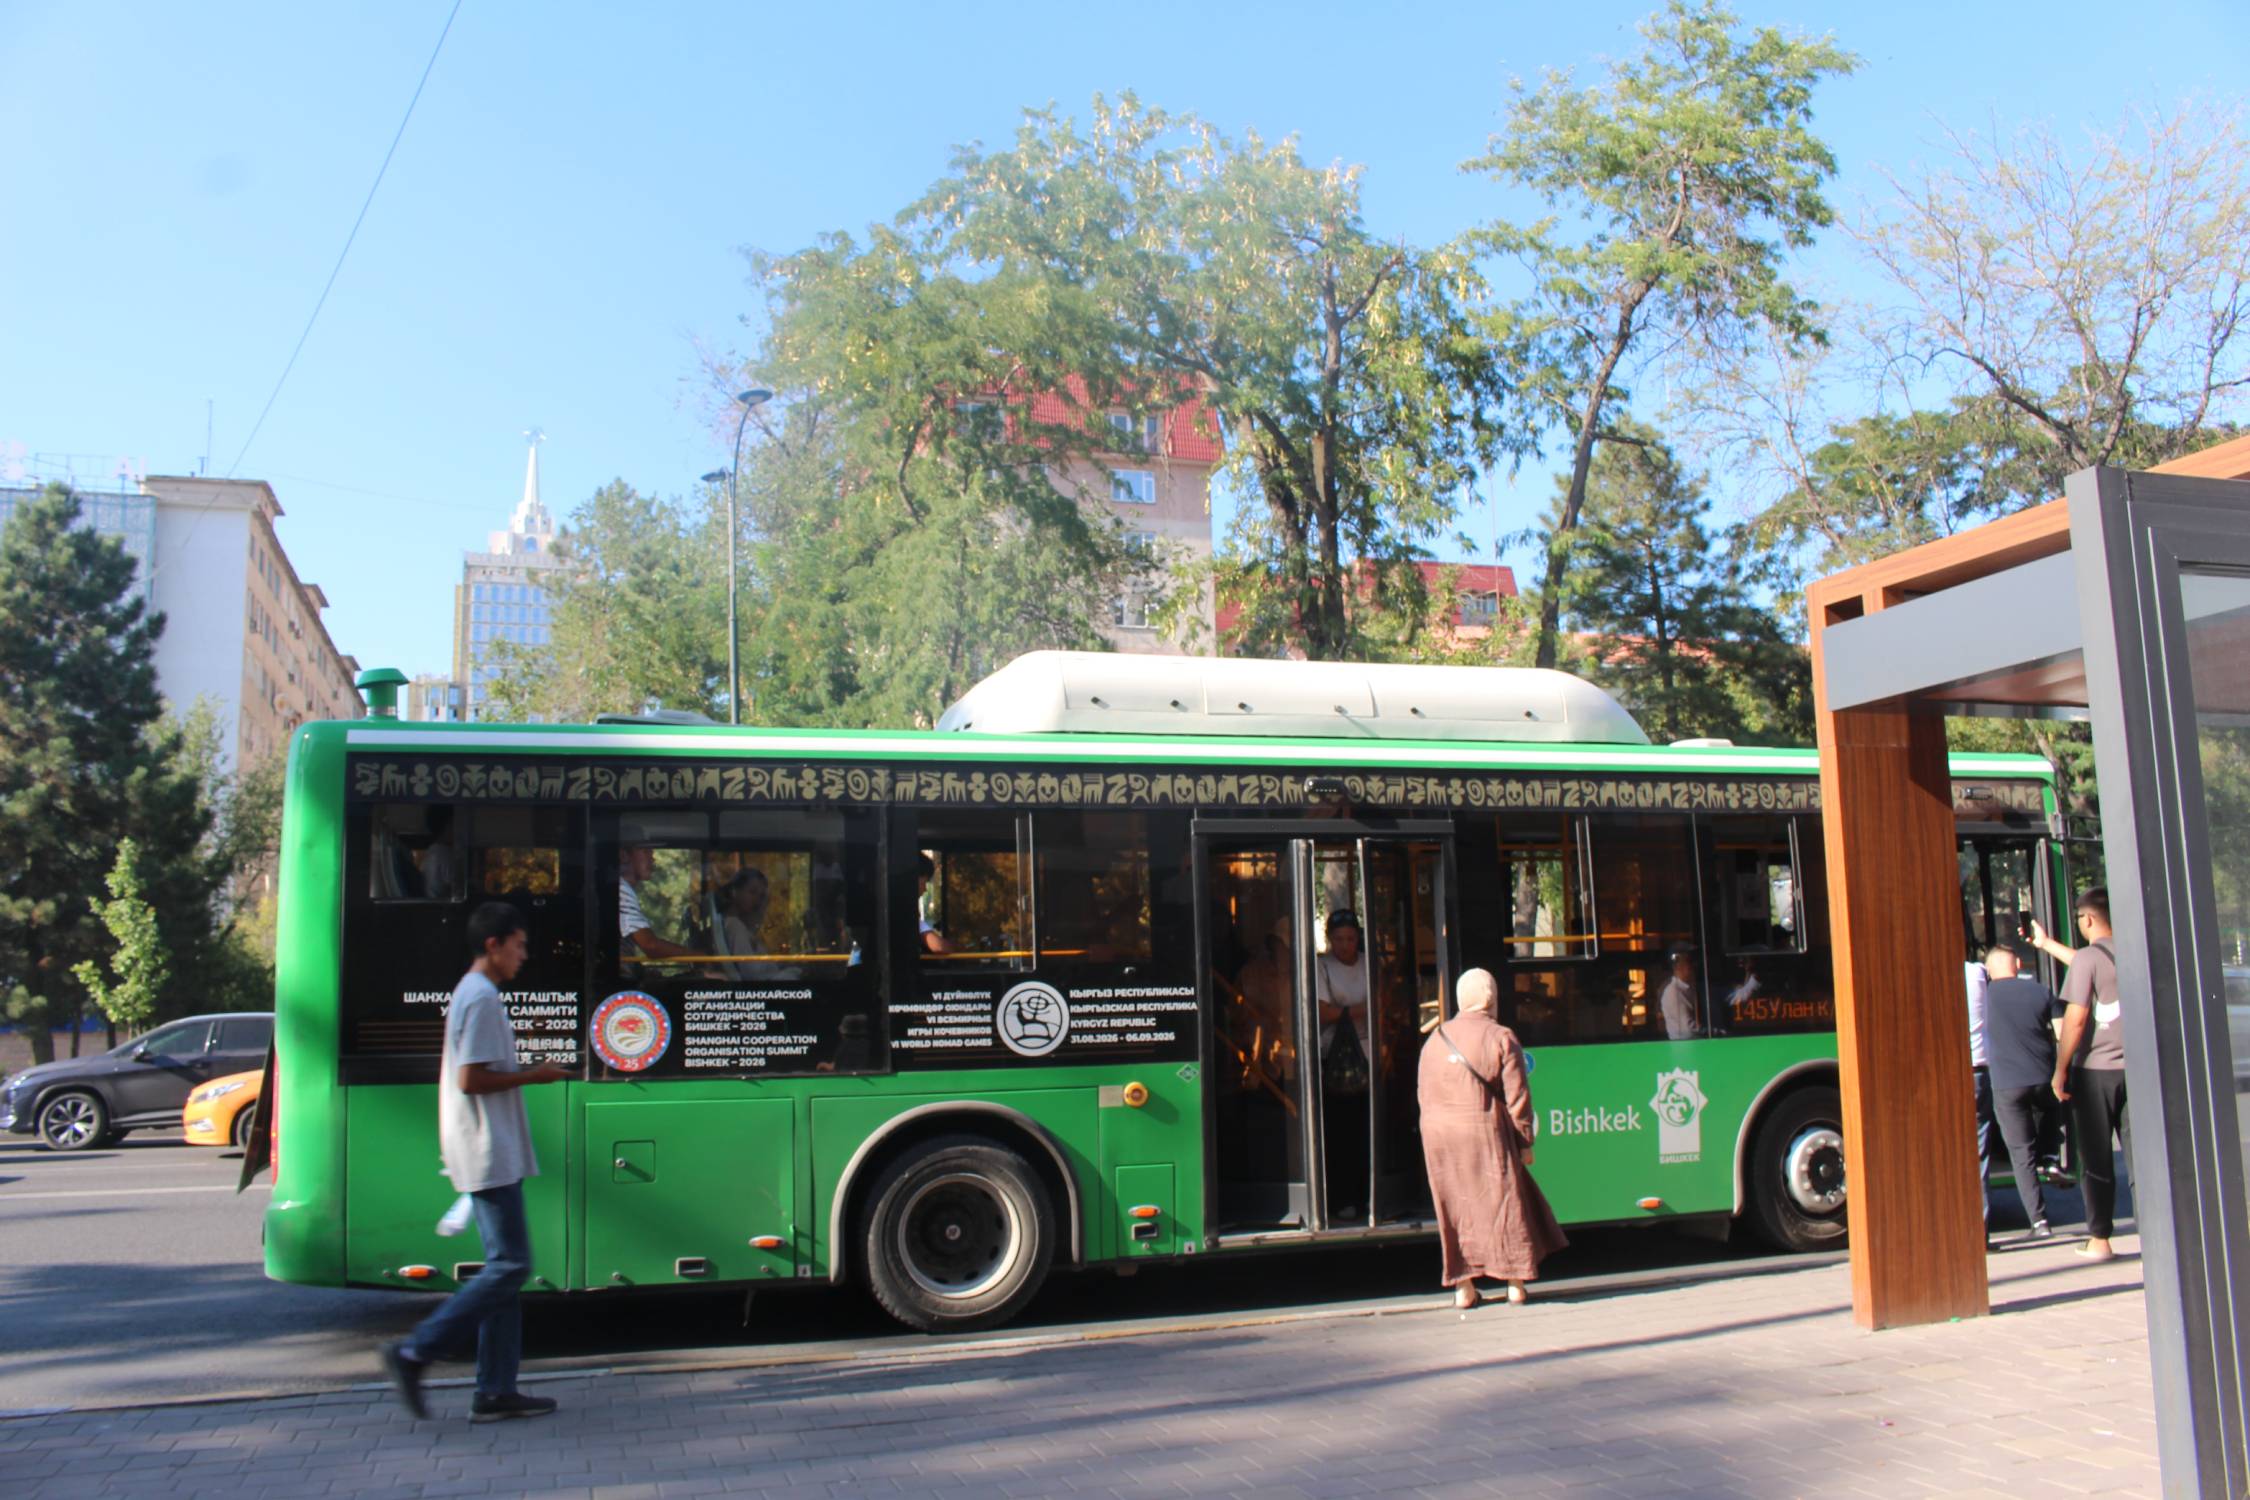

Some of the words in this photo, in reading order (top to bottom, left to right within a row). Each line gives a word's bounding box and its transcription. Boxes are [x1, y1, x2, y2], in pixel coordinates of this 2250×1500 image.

[403, 991, 452, 1003] ШАНХА
[498, 991, 578, 1003] АТТАШТЫК
[684, 990, 733, 1000] САММИТ
[734, 989, 812, 1000] ШАНХАЙСКОЙ
[1069, 988, 1113, 999] КЫРГЫЗ
[1114, 986, 1194, 998] РЕСПУБЛИКАСЫ
[510, 1005, 578, 1017] САММИТИ
[684, 1001, 766, 1012] ОРГАНИЗАЦИИ
[1069, 1003, 1136, 1013] КЫРГЫЗСКАЯ
[1136, 1001, 1198, 1012] РЕСПУБЛИКА
[684, 1011, 786, 1022] СОТРУДНИЧЕСТВА
[545, 1019, 578, 1030] 2026
[684, 1021, 731, 1032] БИШКЕК
[740, 1021, 768, 1031] 2026
[1070, 1018, 1109, 1028] KYRGYZ
[1109, 1017, 1157, 1027] REPUBLIC
[907, 1027, 933, 1037] ИГРЫ
[1070, 1033, 1119, 1044] 31.08.2026
[1125, 1031, 1176, 1042] 06.09.2026
[684, 1036, 741, 1046] SHANGHAI
[742, 1035, 818, 1044] COOPERATION
[901, 1039, 931, 1048] WORLD
[932, 1039, 963, 1048] NOMAD
[964, 1038, 993, 1047] GAMES
[684, 1046, 765, 1057] ORGANISATION
[766, 1045, 809, 1055] SUMMIT
[545, 1052, 578, 1064] 2026
[684, 1057, 730, 1068] BISHKEK
[738, 1057, 767, 1067] 2026
[624, 1058, 640, 1070] 25
[1549, 1104, 1642, 1136] Bishkek
